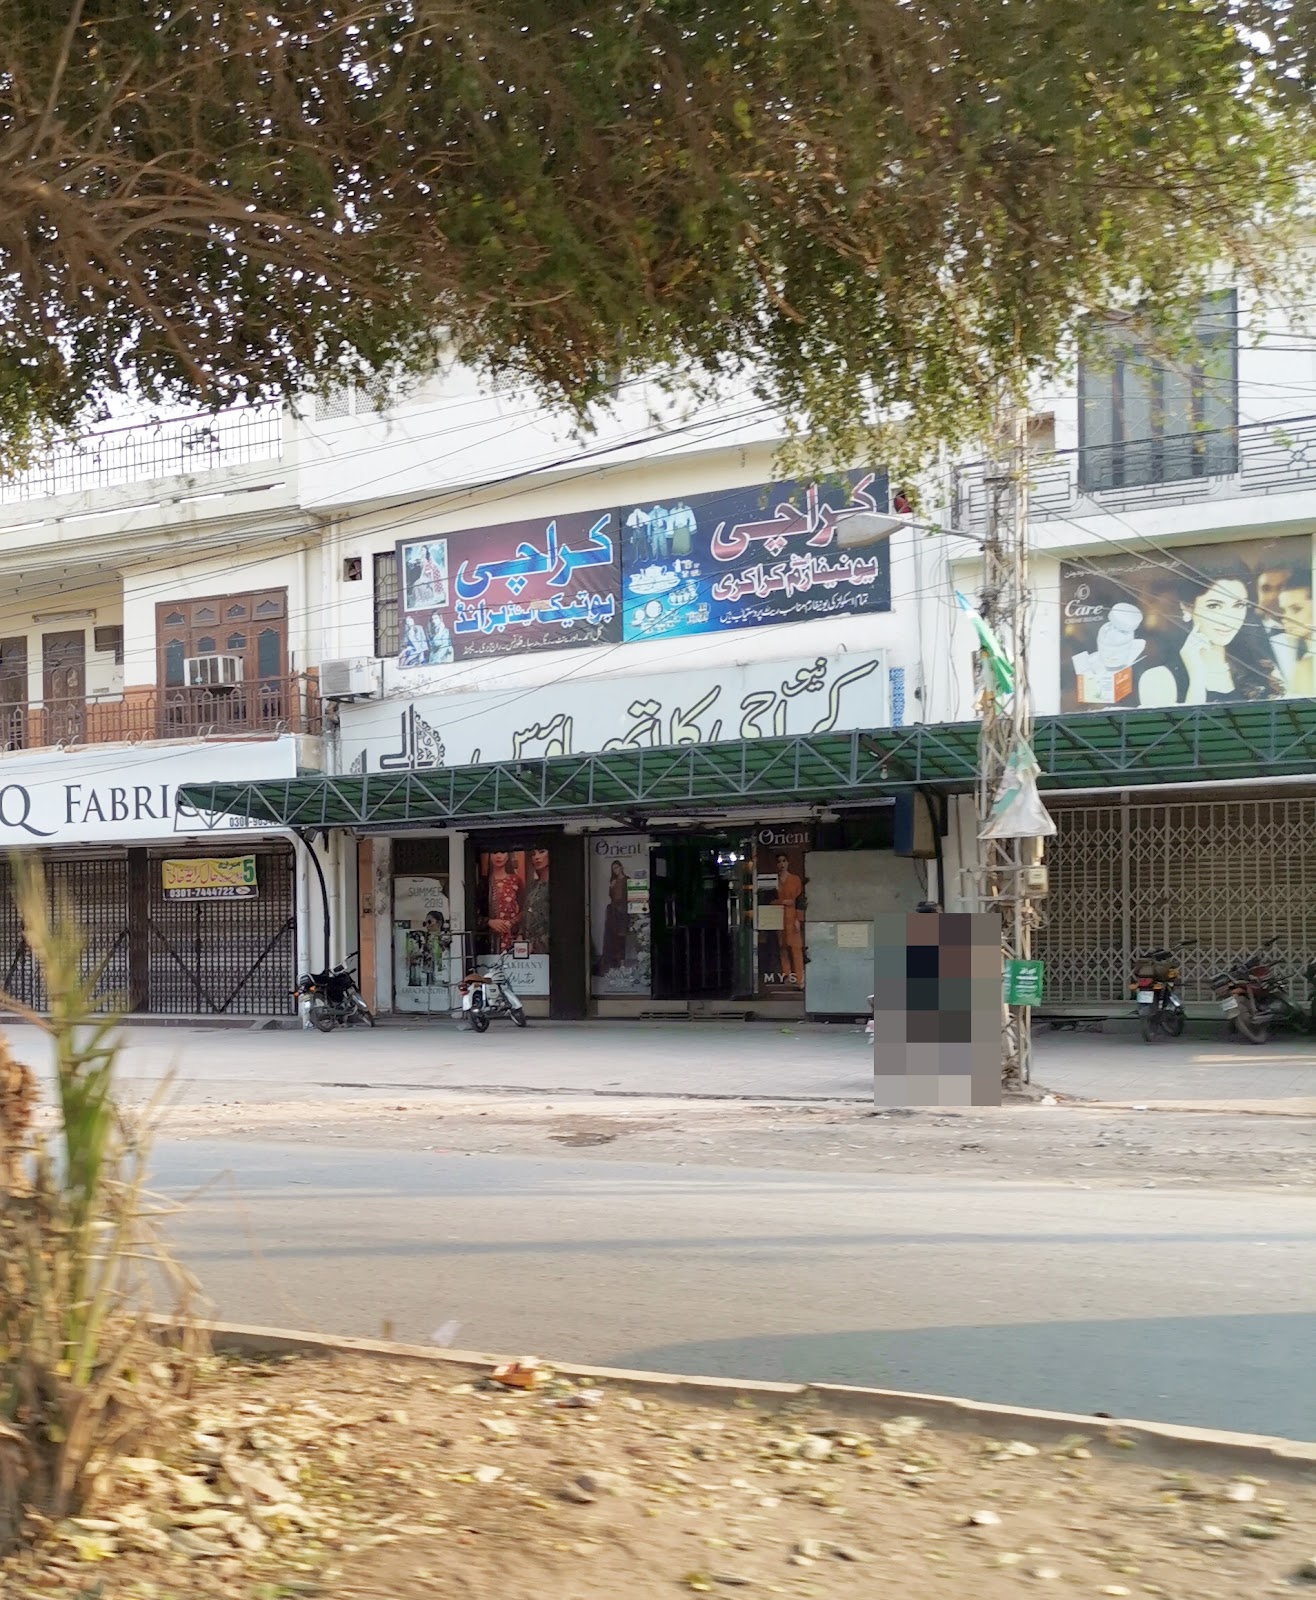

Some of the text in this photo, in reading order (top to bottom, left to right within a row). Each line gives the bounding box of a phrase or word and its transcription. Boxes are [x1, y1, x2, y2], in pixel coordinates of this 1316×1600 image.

[710, 472, 878, 562] کراچی
[454, 512, 614, 601] کراچی
[1064, 599, 1104, 618] Care
[780, 656, 828, 698] نیو
[0, 783, 59, 837] Q
[758, 827, 811, 845] Orient
[595, 838, 642, 856] Orient
[242, 858, 255, 883] 5
[168, 885, 236, 898] 0301-7444722
[408, 886, 443, 897] SUMMER
[424, 897, 444, 908] 2019
